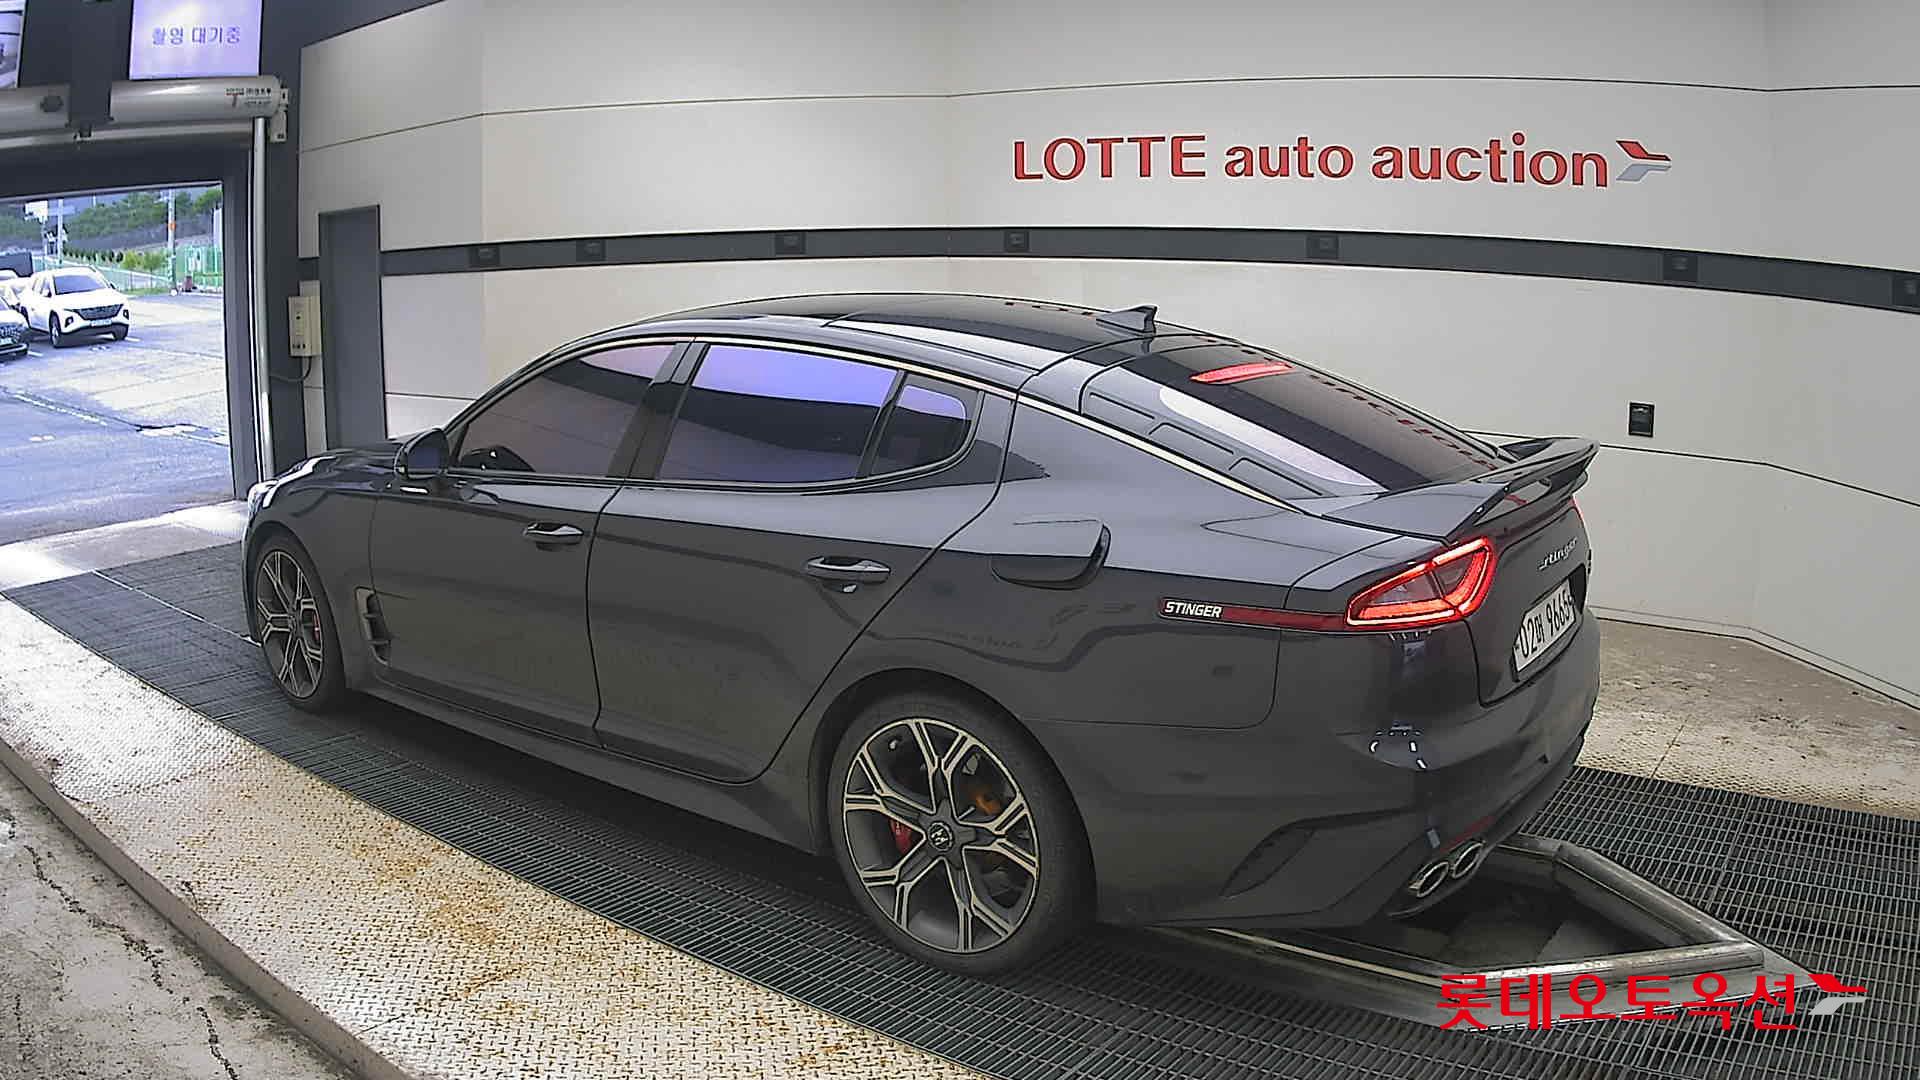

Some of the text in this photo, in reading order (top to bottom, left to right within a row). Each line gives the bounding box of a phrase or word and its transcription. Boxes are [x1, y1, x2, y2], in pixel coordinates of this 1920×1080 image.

[191, 26, 241, 44] 대기중
[1013, 132, 1609, 188] LOTTE auto auction
[1164, 601, 1222, 618] STINGER
